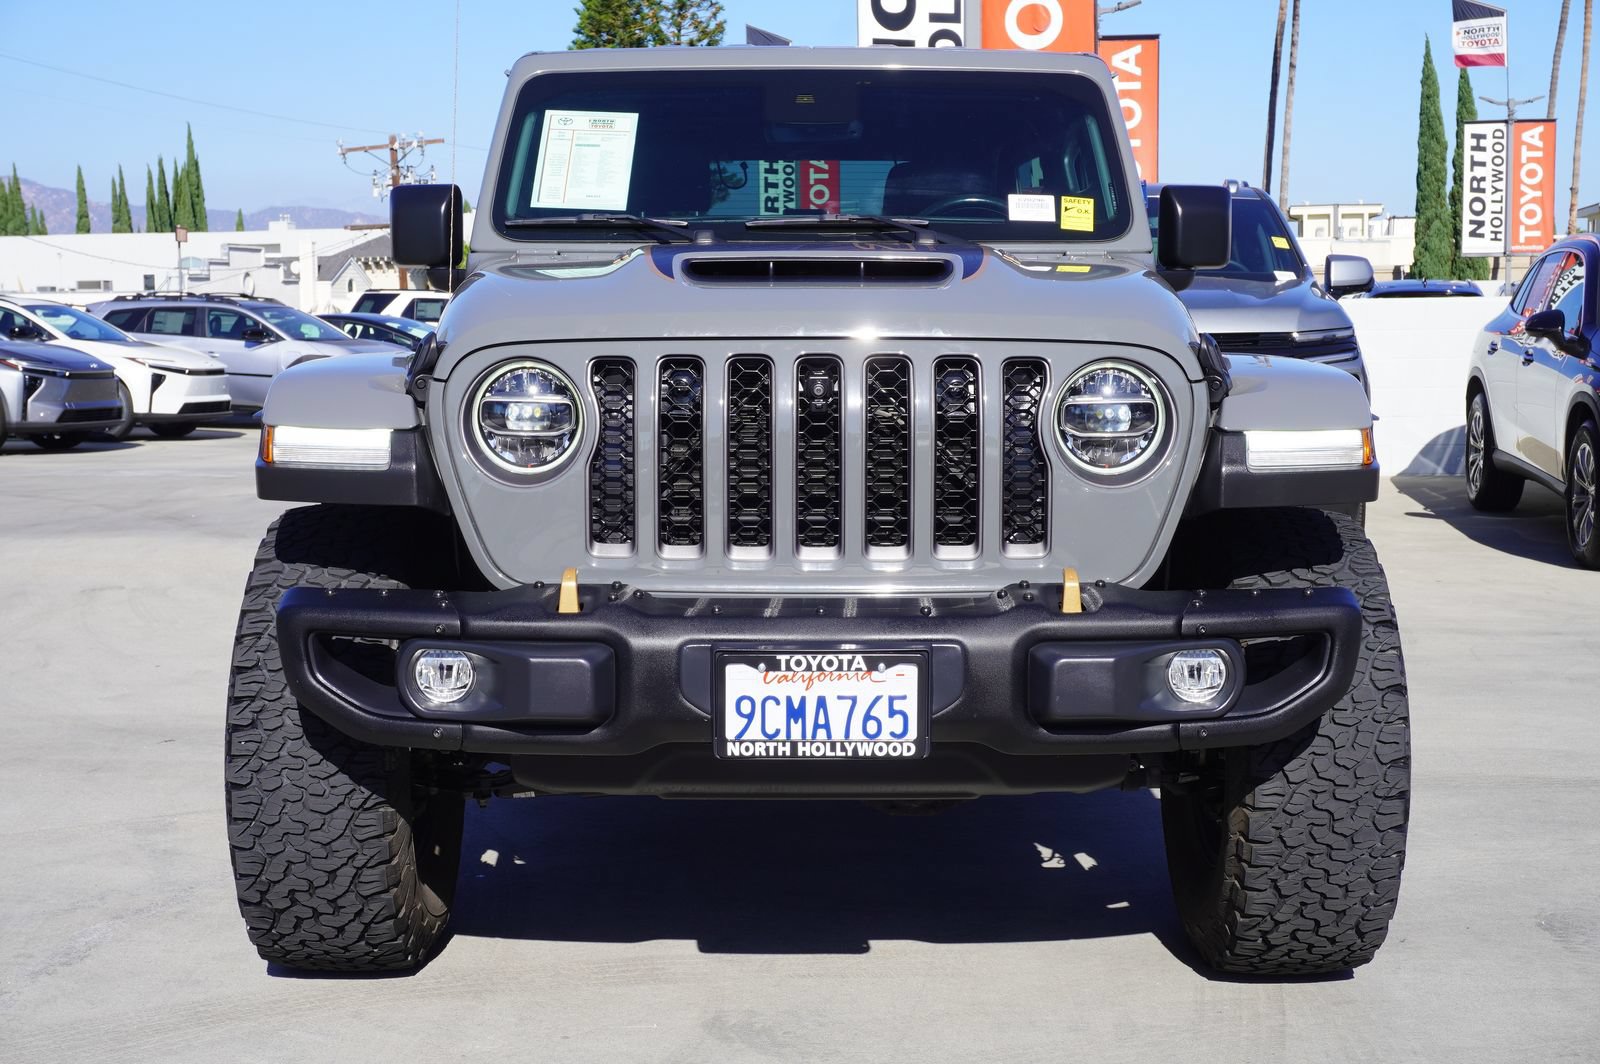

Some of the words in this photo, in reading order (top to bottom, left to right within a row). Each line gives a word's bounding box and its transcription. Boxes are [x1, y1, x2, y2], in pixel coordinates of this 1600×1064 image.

[1464, 27, 1499, 35] NORTH
[1461, 38, 1499, 47] TOYOTA
[1469, 132, 1487, 239] NORTH
[1490, 128, 1505, 242] HOLLYWOOD
[1519, 125, 1544, 244] TOYOTA
[776, 654, 867, 671] TOYOTA
[763, 671, 886, 691] California
[734, 694, 909, 741] 9CMA765
[727, 742, 790, 756] NORTH
[797, 742, 916, 756] HOLLYWOOD
